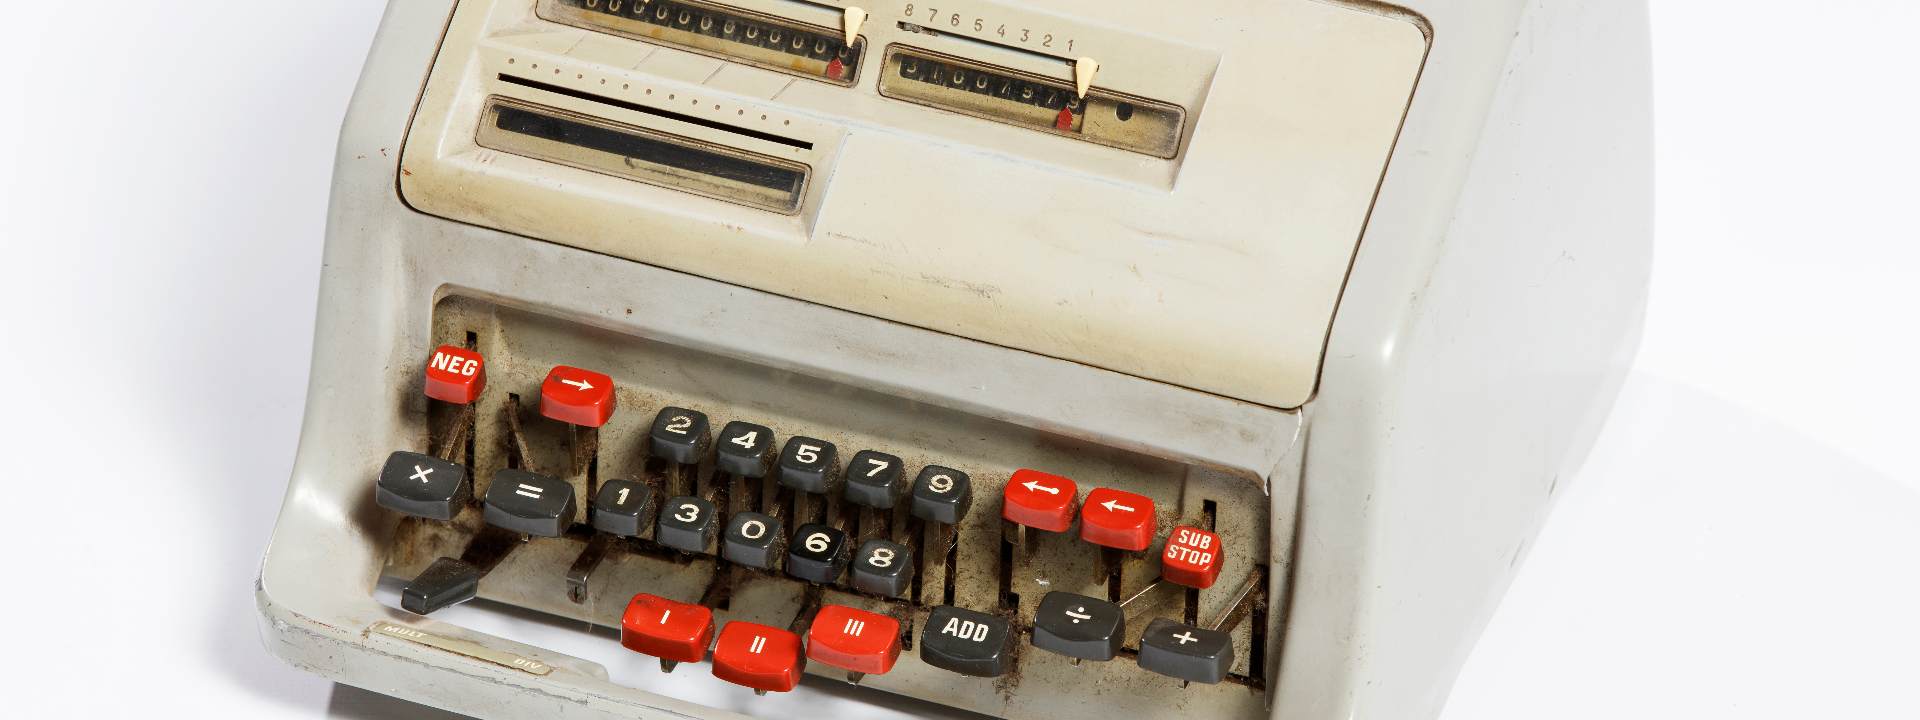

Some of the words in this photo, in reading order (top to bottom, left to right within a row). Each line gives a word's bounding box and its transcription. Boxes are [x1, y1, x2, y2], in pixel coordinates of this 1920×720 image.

[904, 3, 914, 17] 8
[928, 8, 938, 23] 7
[950, 13, 960, 27] 6
[973, 18, 983, 32] 5
[996, 23, 1006, 38] 4
[1020, 28, 1030, 42] 3
[1042, 34, 1053, 48] 2
[1066, 39, 1074, 52] 1
[430, 351, 479, 377] NEG
[665, 415, 692, 434] 2
[731, 430, 757, 450] 4
[795, 444, 821, 464] 5
[866, 458, 889, 478] 7
[928, 474, 954, 494] 9
[616, 487, 631, 505] 1
[674, 503, 700, 523] 3
[740, 519, 767, 540] 0
[1178, 529, 1212, 550] SUB
[805, 532, 831, 553] 6
[868, 546, 894, 568] 8
[1167, 544, 1212, 566] STOP
[384, 625, 427, 638] MULT
[843, 618, 865, 637] III
[941, 617, 990, 643] ADD
[749, 635, 767, 654] II
[514, 658, 543, 669] DIV
